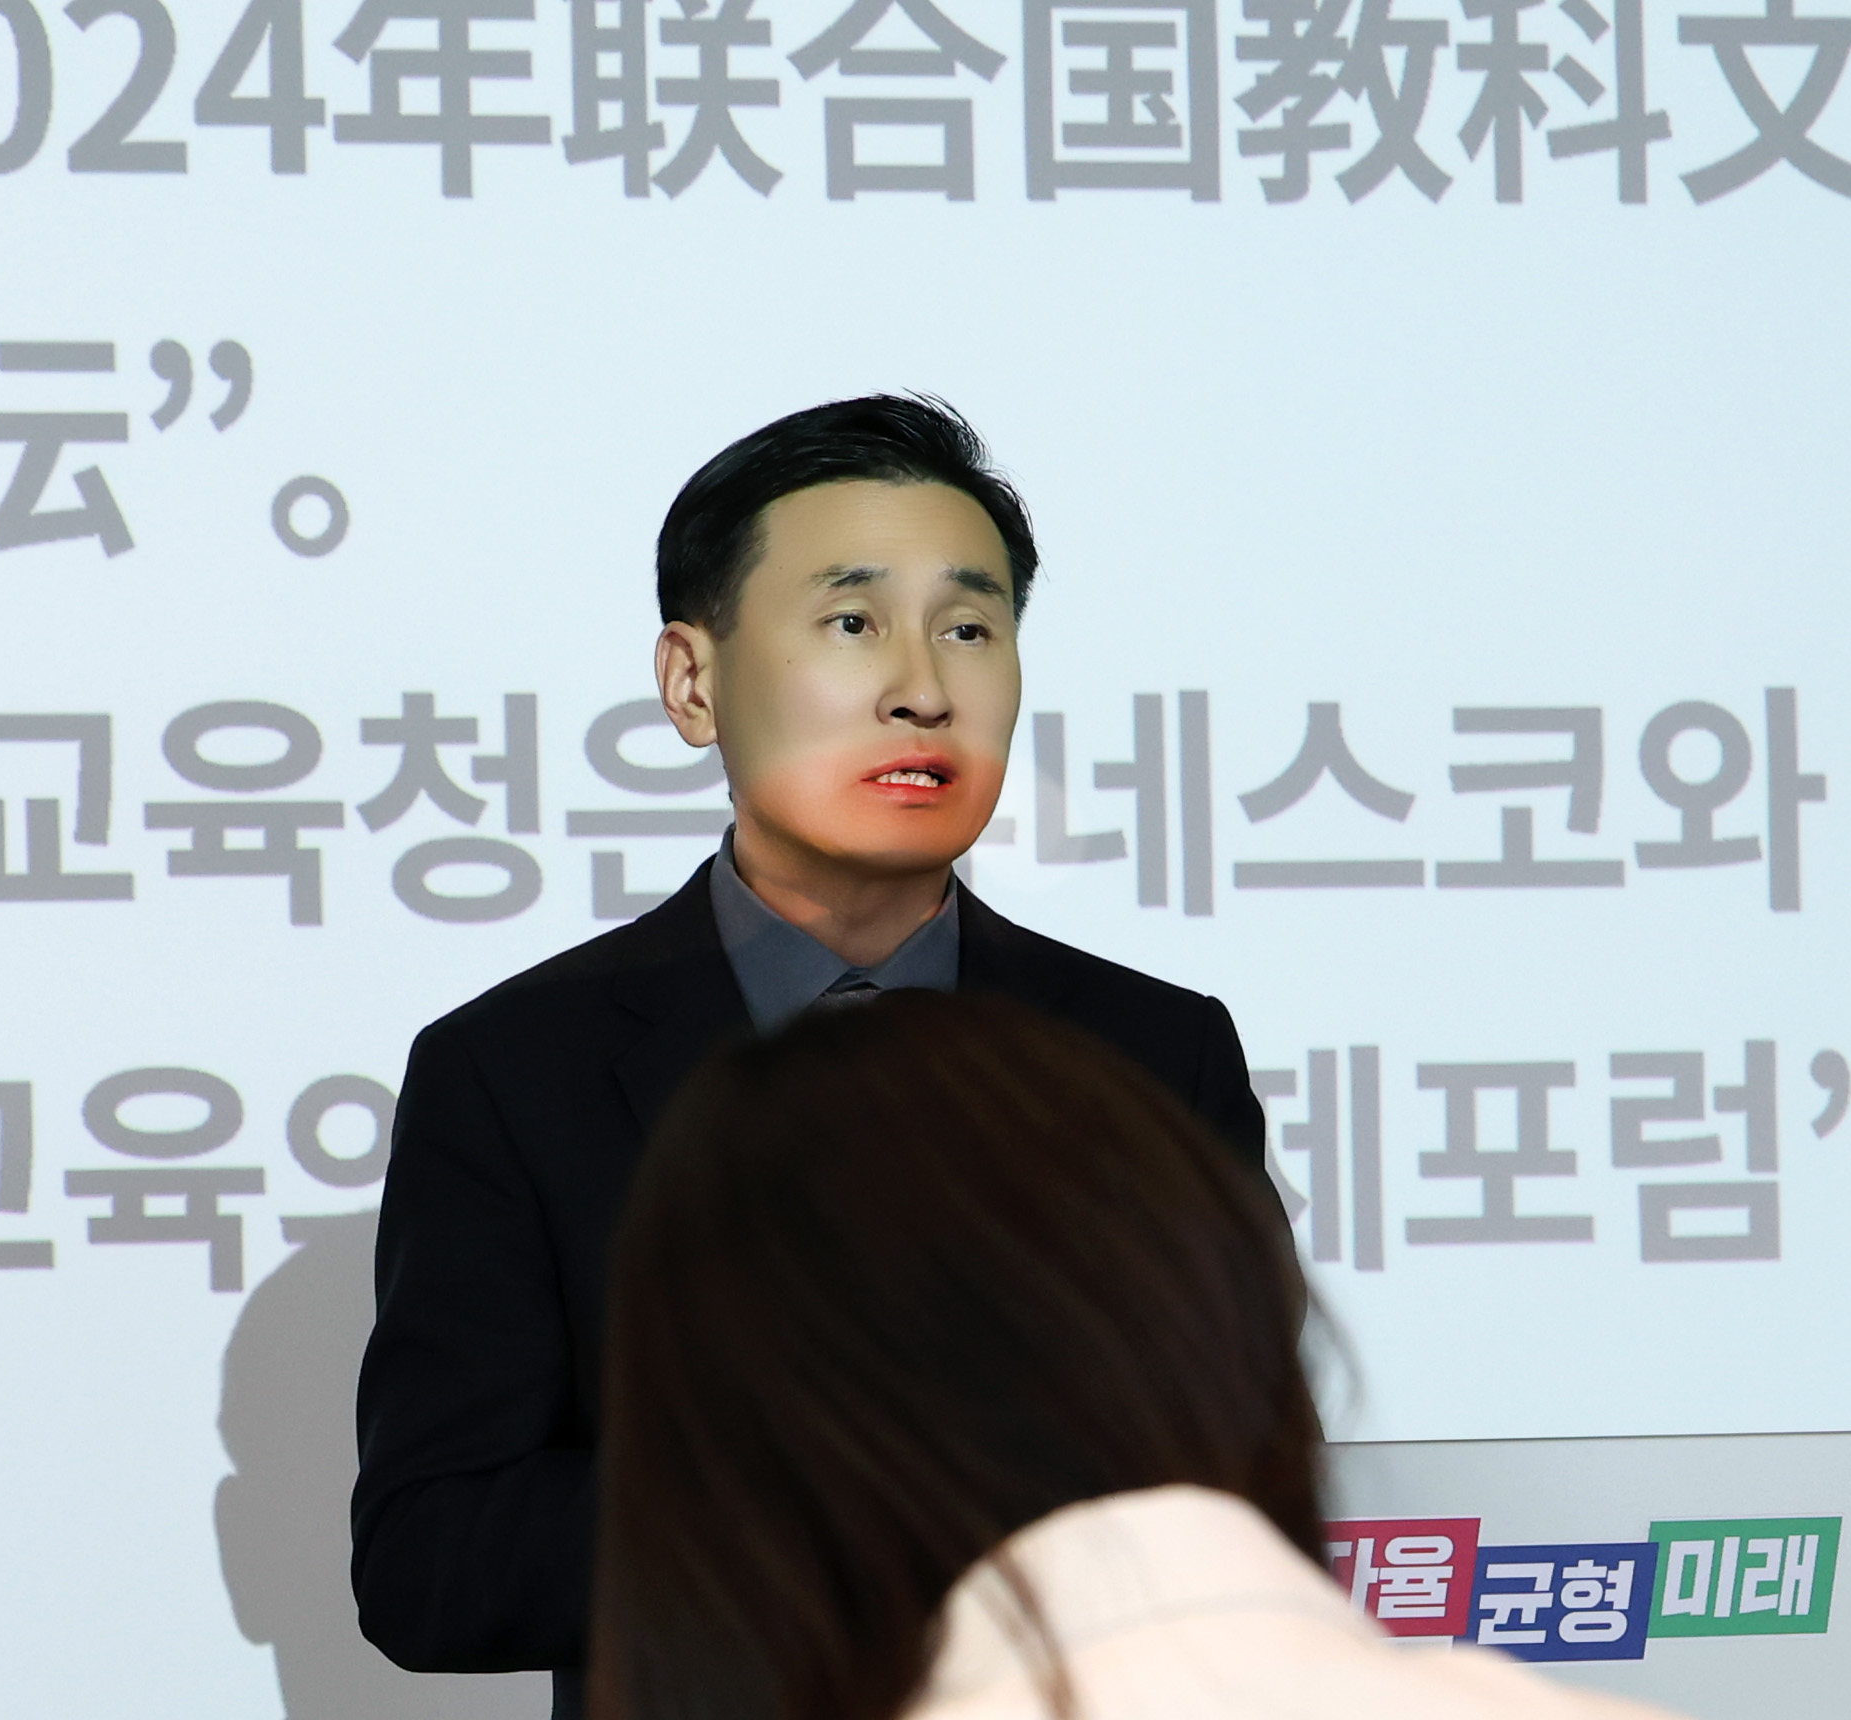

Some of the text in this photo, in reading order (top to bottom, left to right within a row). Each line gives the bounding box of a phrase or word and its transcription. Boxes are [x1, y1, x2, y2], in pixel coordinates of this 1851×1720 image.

[968, 686, 1827, 918] 네스코와
[1476, 1557, 1636, 1645] 균형
[1660, 1533, 1820, 1619] 미래
